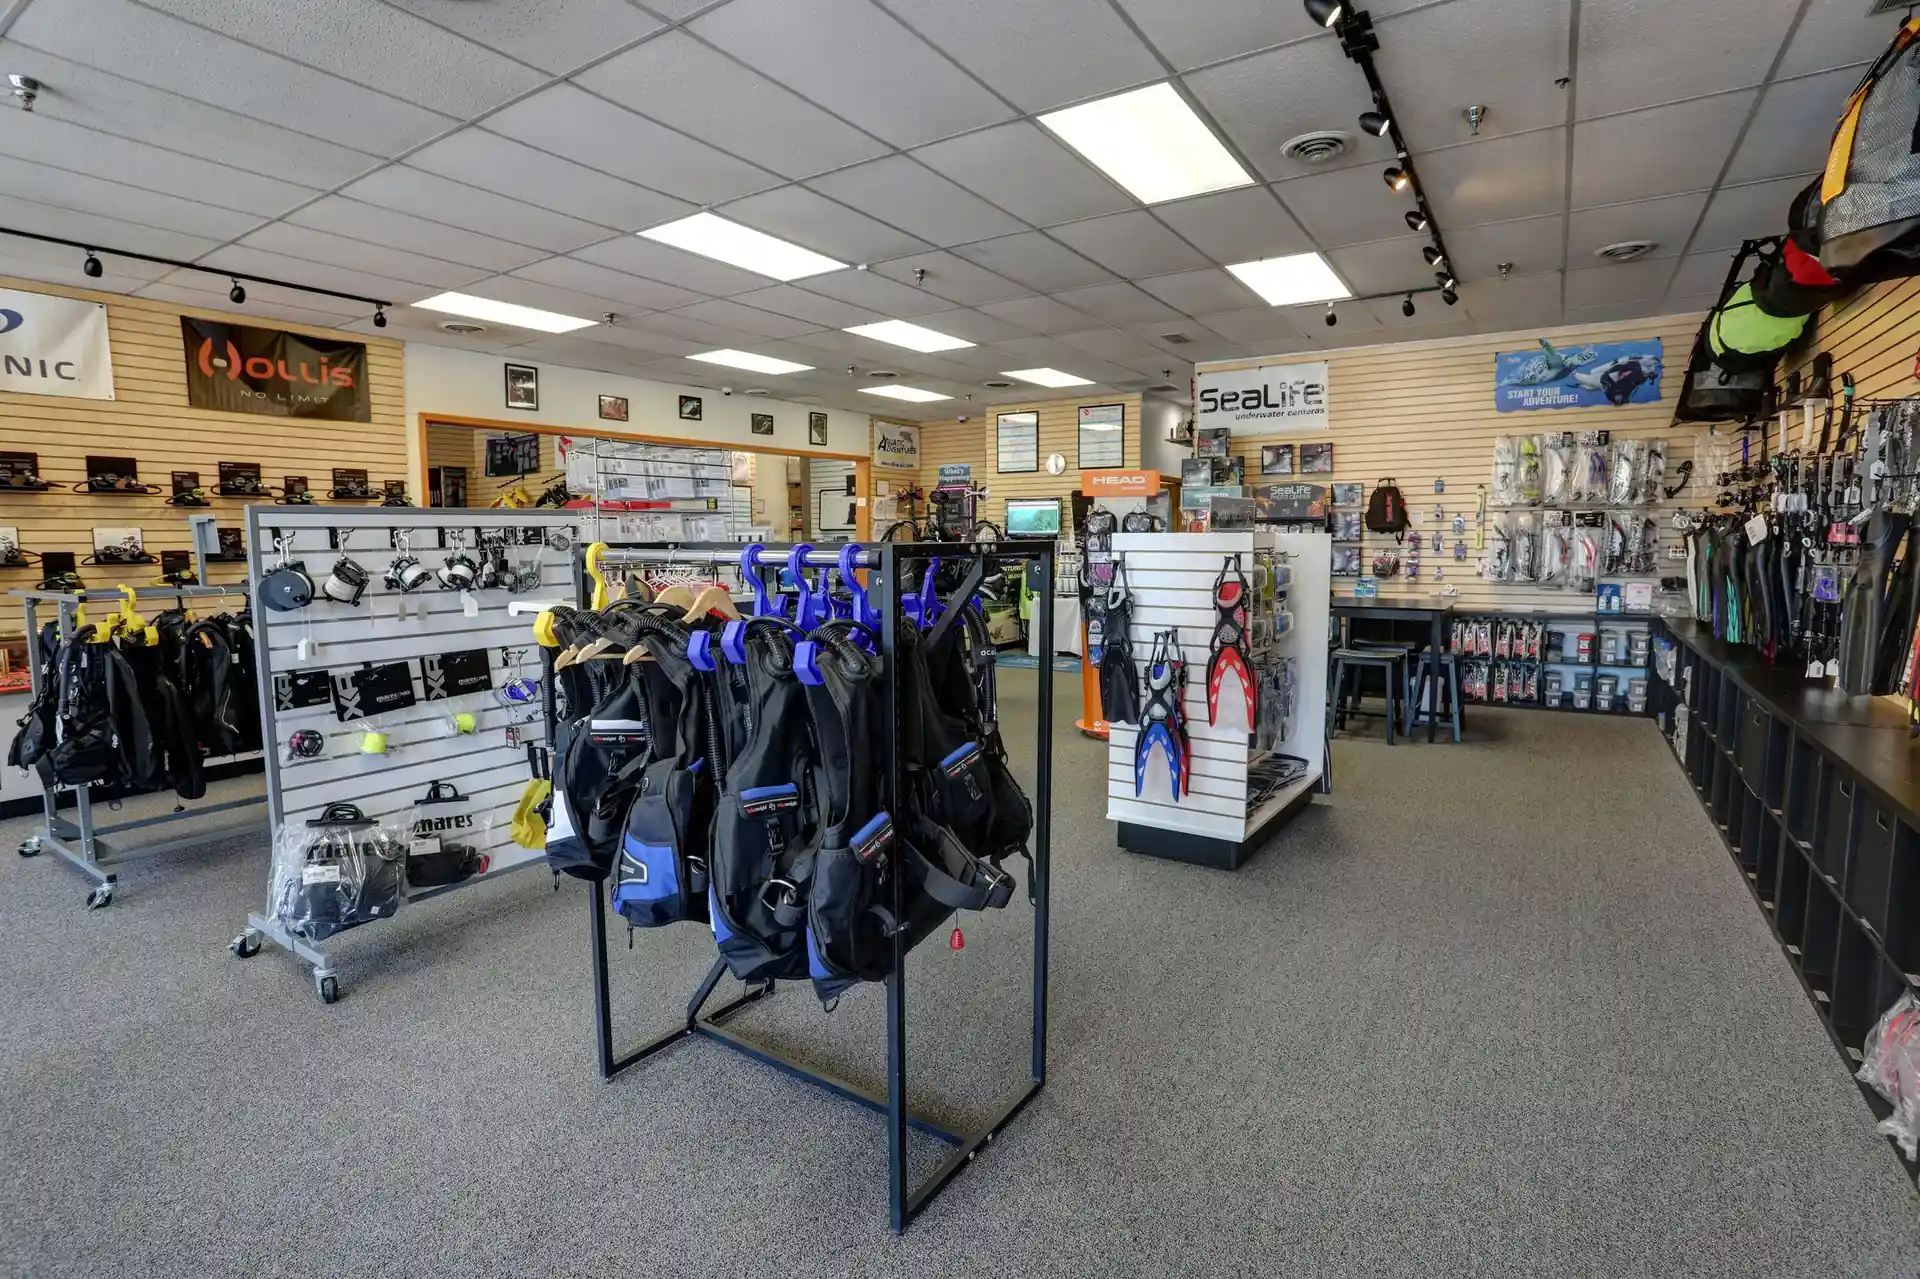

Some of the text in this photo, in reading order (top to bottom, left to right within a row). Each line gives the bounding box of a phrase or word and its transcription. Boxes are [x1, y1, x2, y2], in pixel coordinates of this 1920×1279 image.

[240, 389, 330, 404] NO LIMIT
[1507, 387, 1560, 399] START YOUR
[1523, 394, 1579, 406] ADVENTURE!
[1235, 408, 1325, 420] underwater cameras
[940, 475, 970, 483] Happening
[1092, 476, 1146, 485] HEAD
[413, 813, 473, 834] mares
